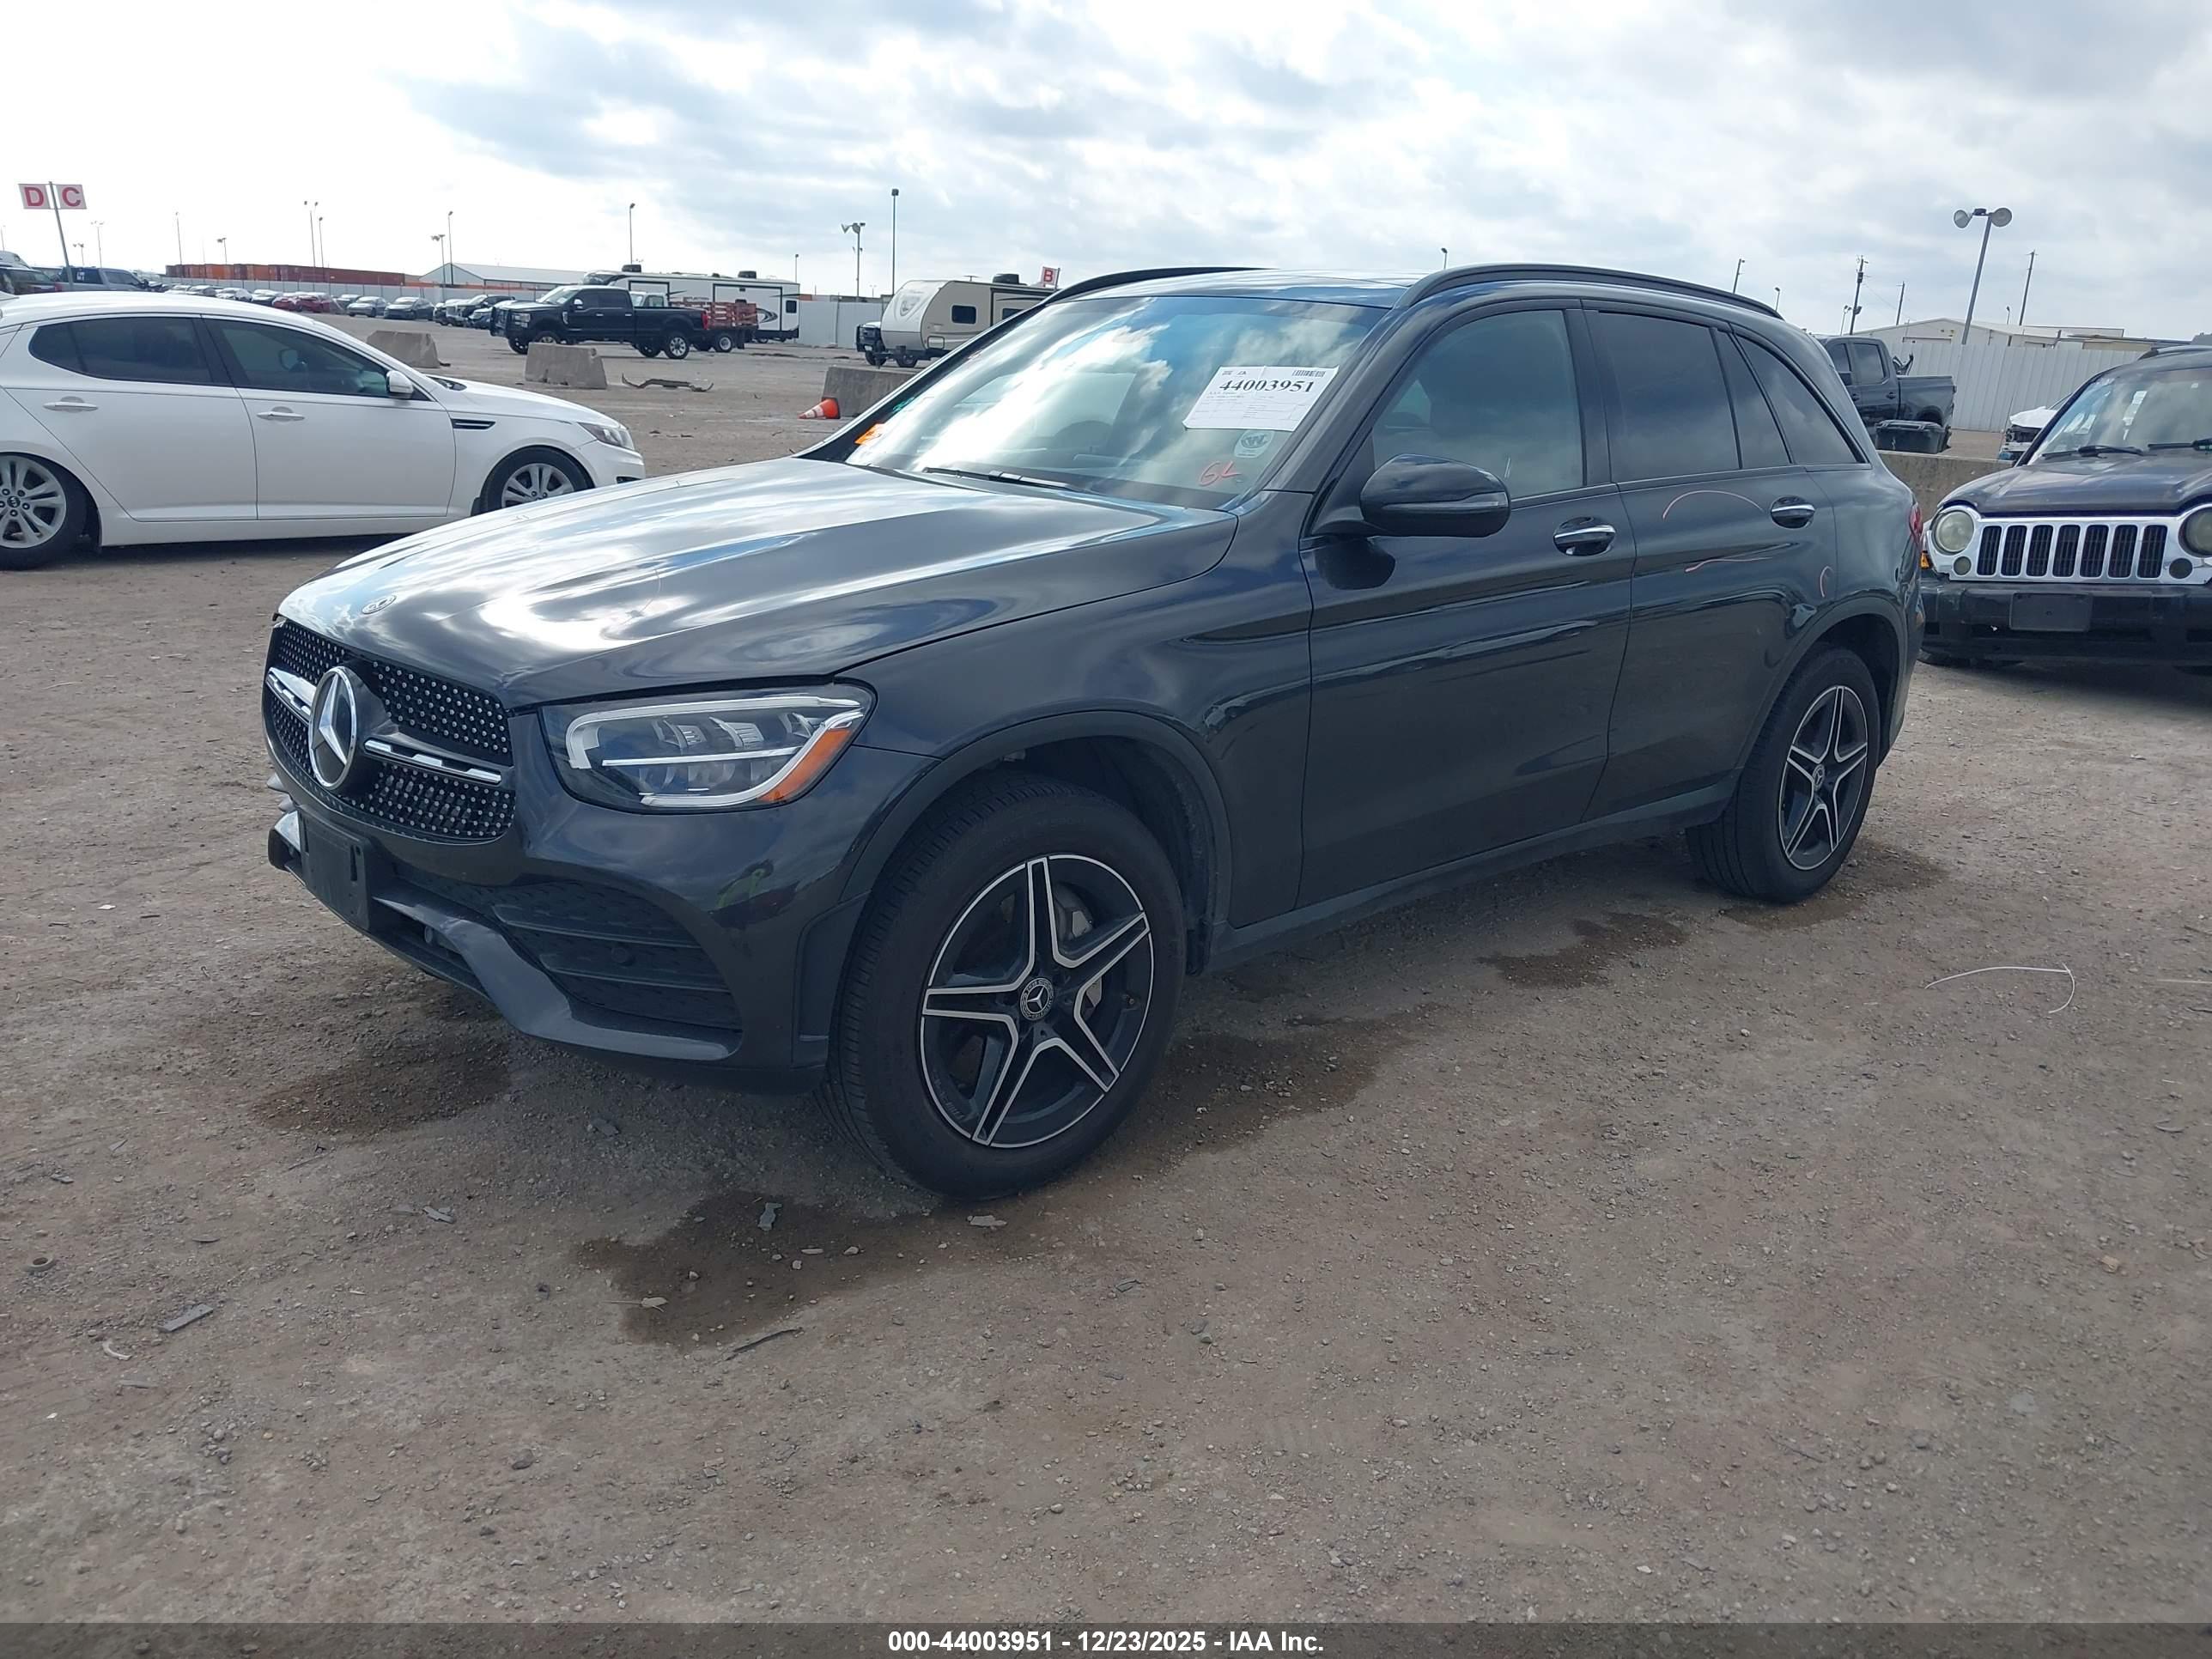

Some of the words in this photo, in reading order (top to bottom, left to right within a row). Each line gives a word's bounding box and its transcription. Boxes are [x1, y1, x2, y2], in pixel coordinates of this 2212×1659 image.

[24, 186, 44, 207] D
[62, 186, 81, 207] C
[1043, 269, 1054, 283] B
[1219, 380, 1315, 392] 44003951
